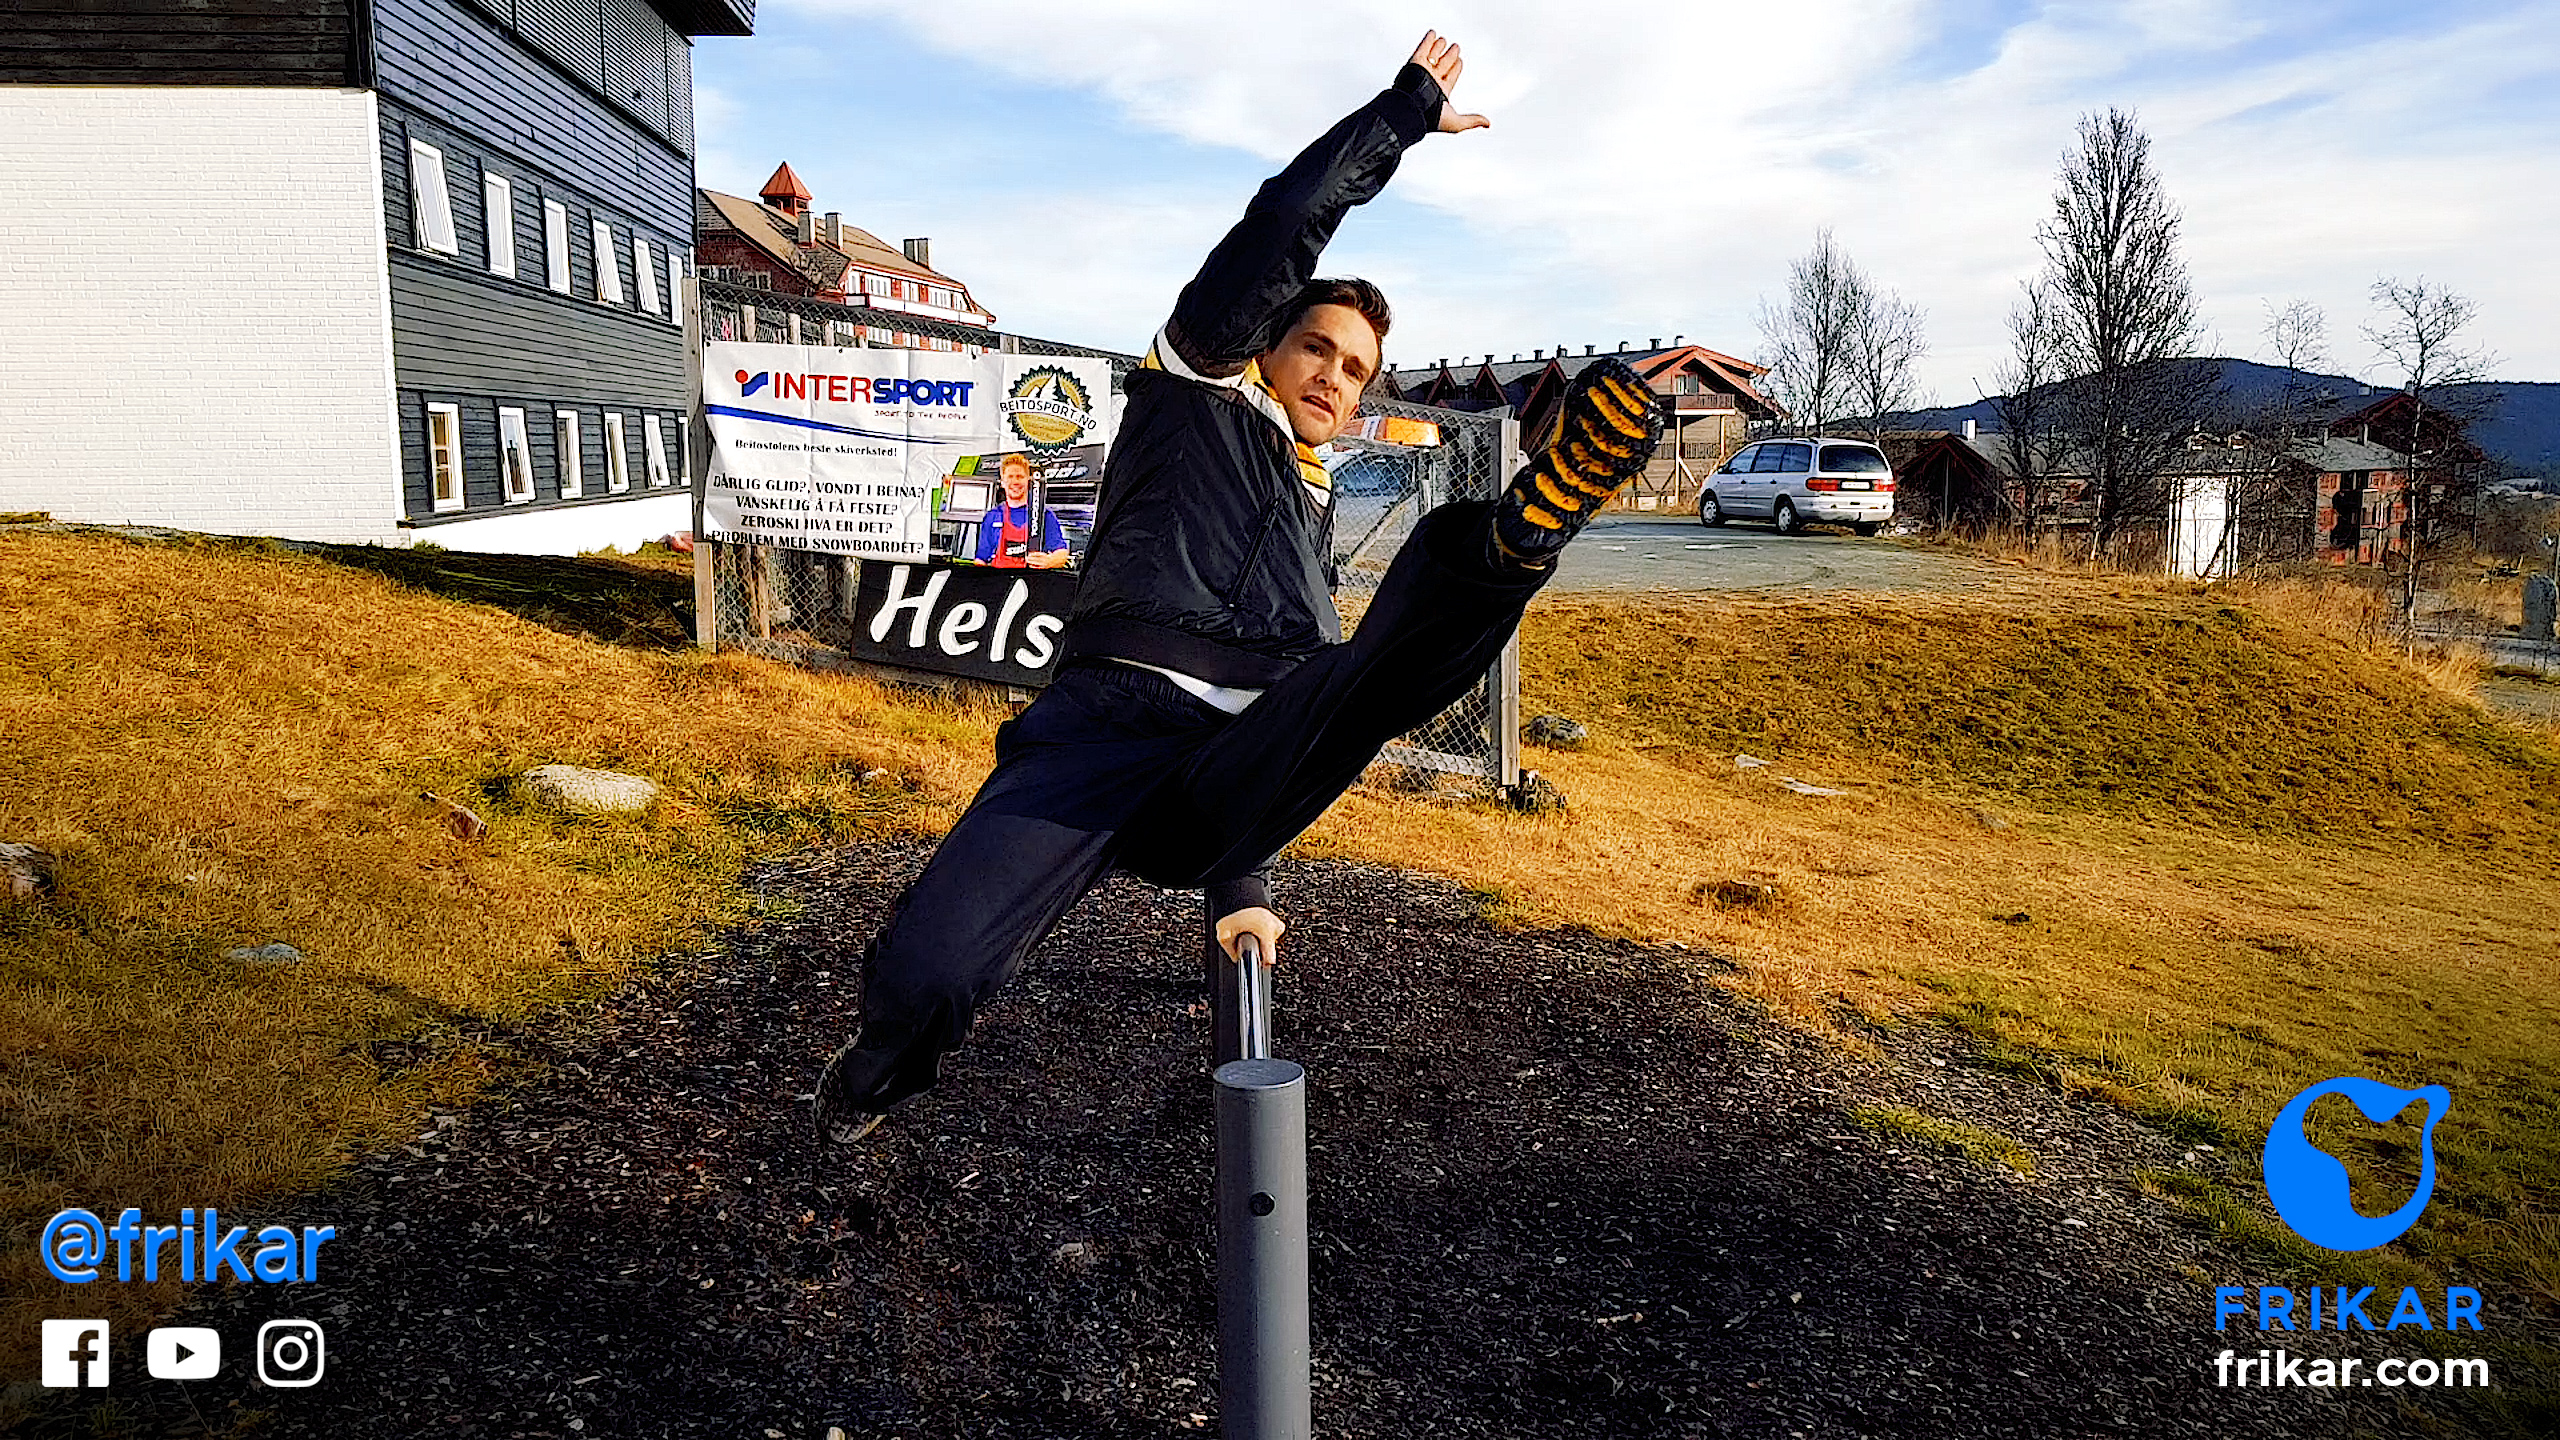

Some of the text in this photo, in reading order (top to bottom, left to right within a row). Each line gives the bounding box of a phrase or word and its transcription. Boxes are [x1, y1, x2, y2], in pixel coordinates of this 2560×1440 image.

[774, 371, 974, 407] INTERSPORT
[1000, 399, 1097, 430] BEITOSPORT.NO
[713, 472, 761, 490] DÅRLIG
[815, 482, 863, 495] VONDT
[867, 484, 872, 496] I
[877, 485, 925, 498] BEINA?
[735, 496, 898, 516] VANSKELIG Å FÅ FESTE?
[740, 515, 893, 534] ZEROSKI HVA ER DET?
[712, 530, 924, 554] PROBLEM MED SNOWBOARDET?
